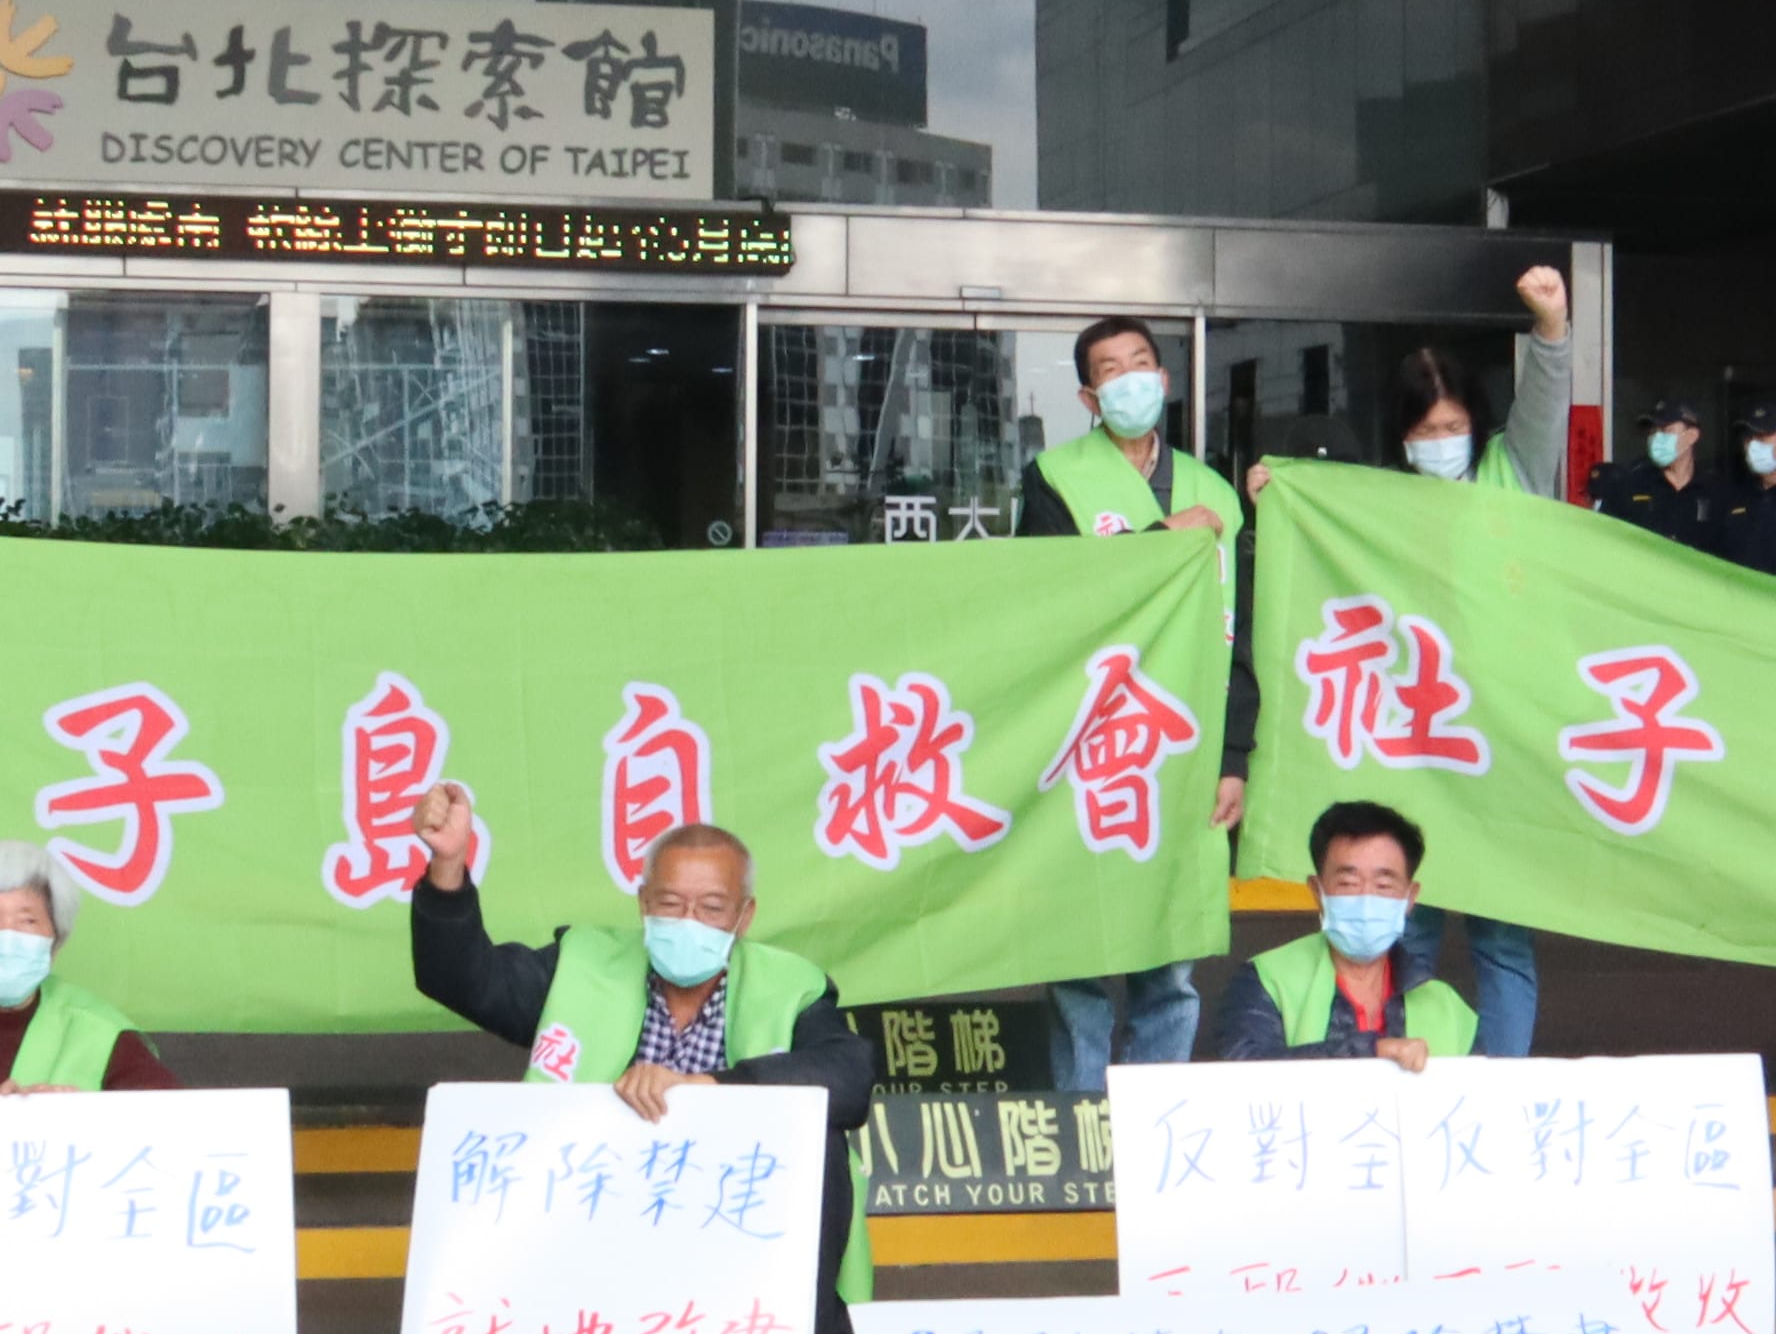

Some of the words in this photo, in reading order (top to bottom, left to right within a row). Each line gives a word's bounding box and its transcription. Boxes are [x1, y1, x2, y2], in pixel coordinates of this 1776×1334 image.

[105, 13, 685, 130] 台北探索館
[101, 132, 320, 167] DISCOVERY
[339, 138, 484, 172] CENTER
[500, 144, 549, 173] OF
[563, 146, 691, 180] TAIPEI
[884, 495, 1019, 543] 西大
[846, 1010, 1006, 1077] 階梯
[1426, 1094, 1742, 1194] 反對全區
[449, 1128, 787, 1242] 解除禁建
[875, 1183, 952, 1207] ATCH
[966, 1182, 1046, 1207] YOUR
